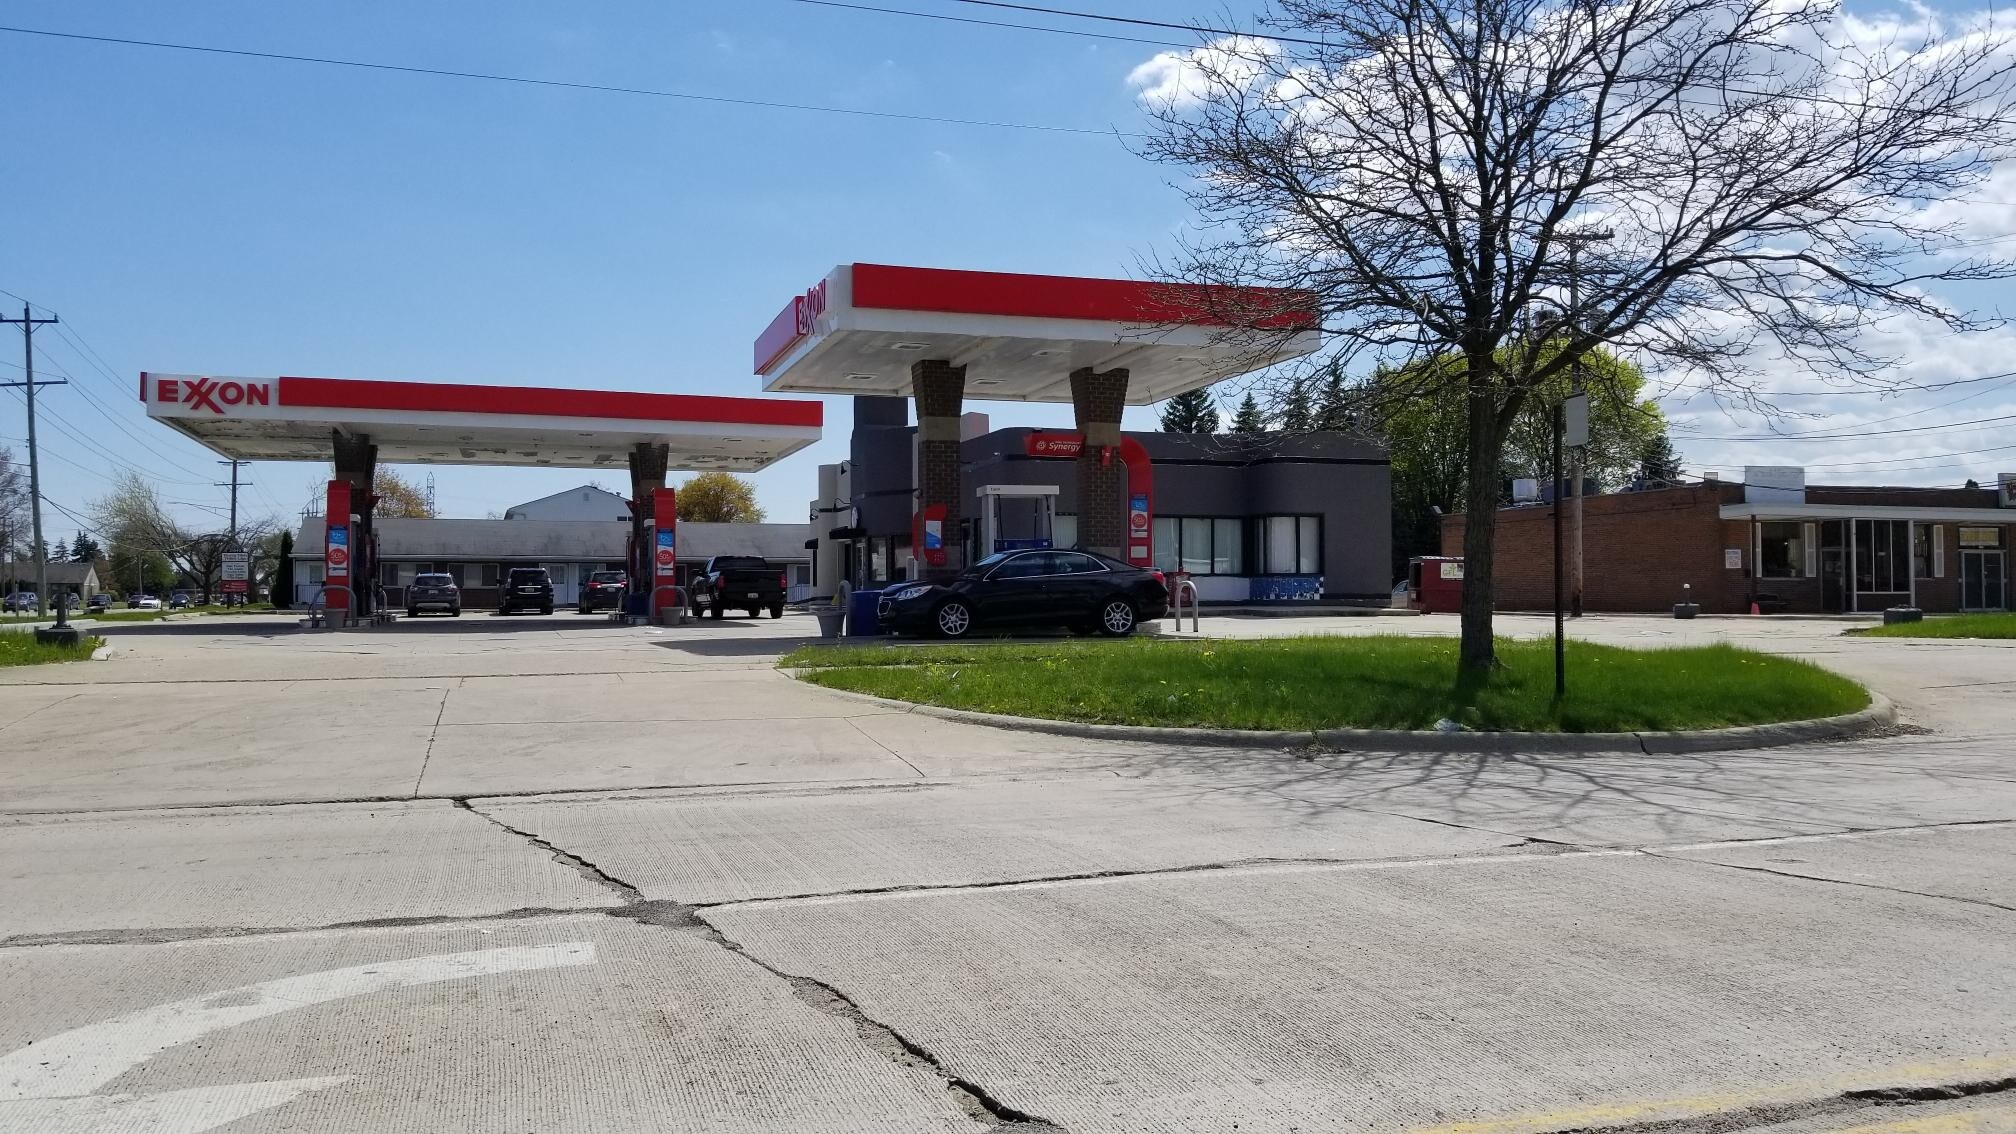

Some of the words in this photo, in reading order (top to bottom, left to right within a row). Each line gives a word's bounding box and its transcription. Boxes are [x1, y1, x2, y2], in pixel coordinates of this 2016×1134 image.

[795, 278, 826, 336] EXXON
[157, 377, 269, 414] EXXON
[1048, 442, 1081, 452] Synergy
